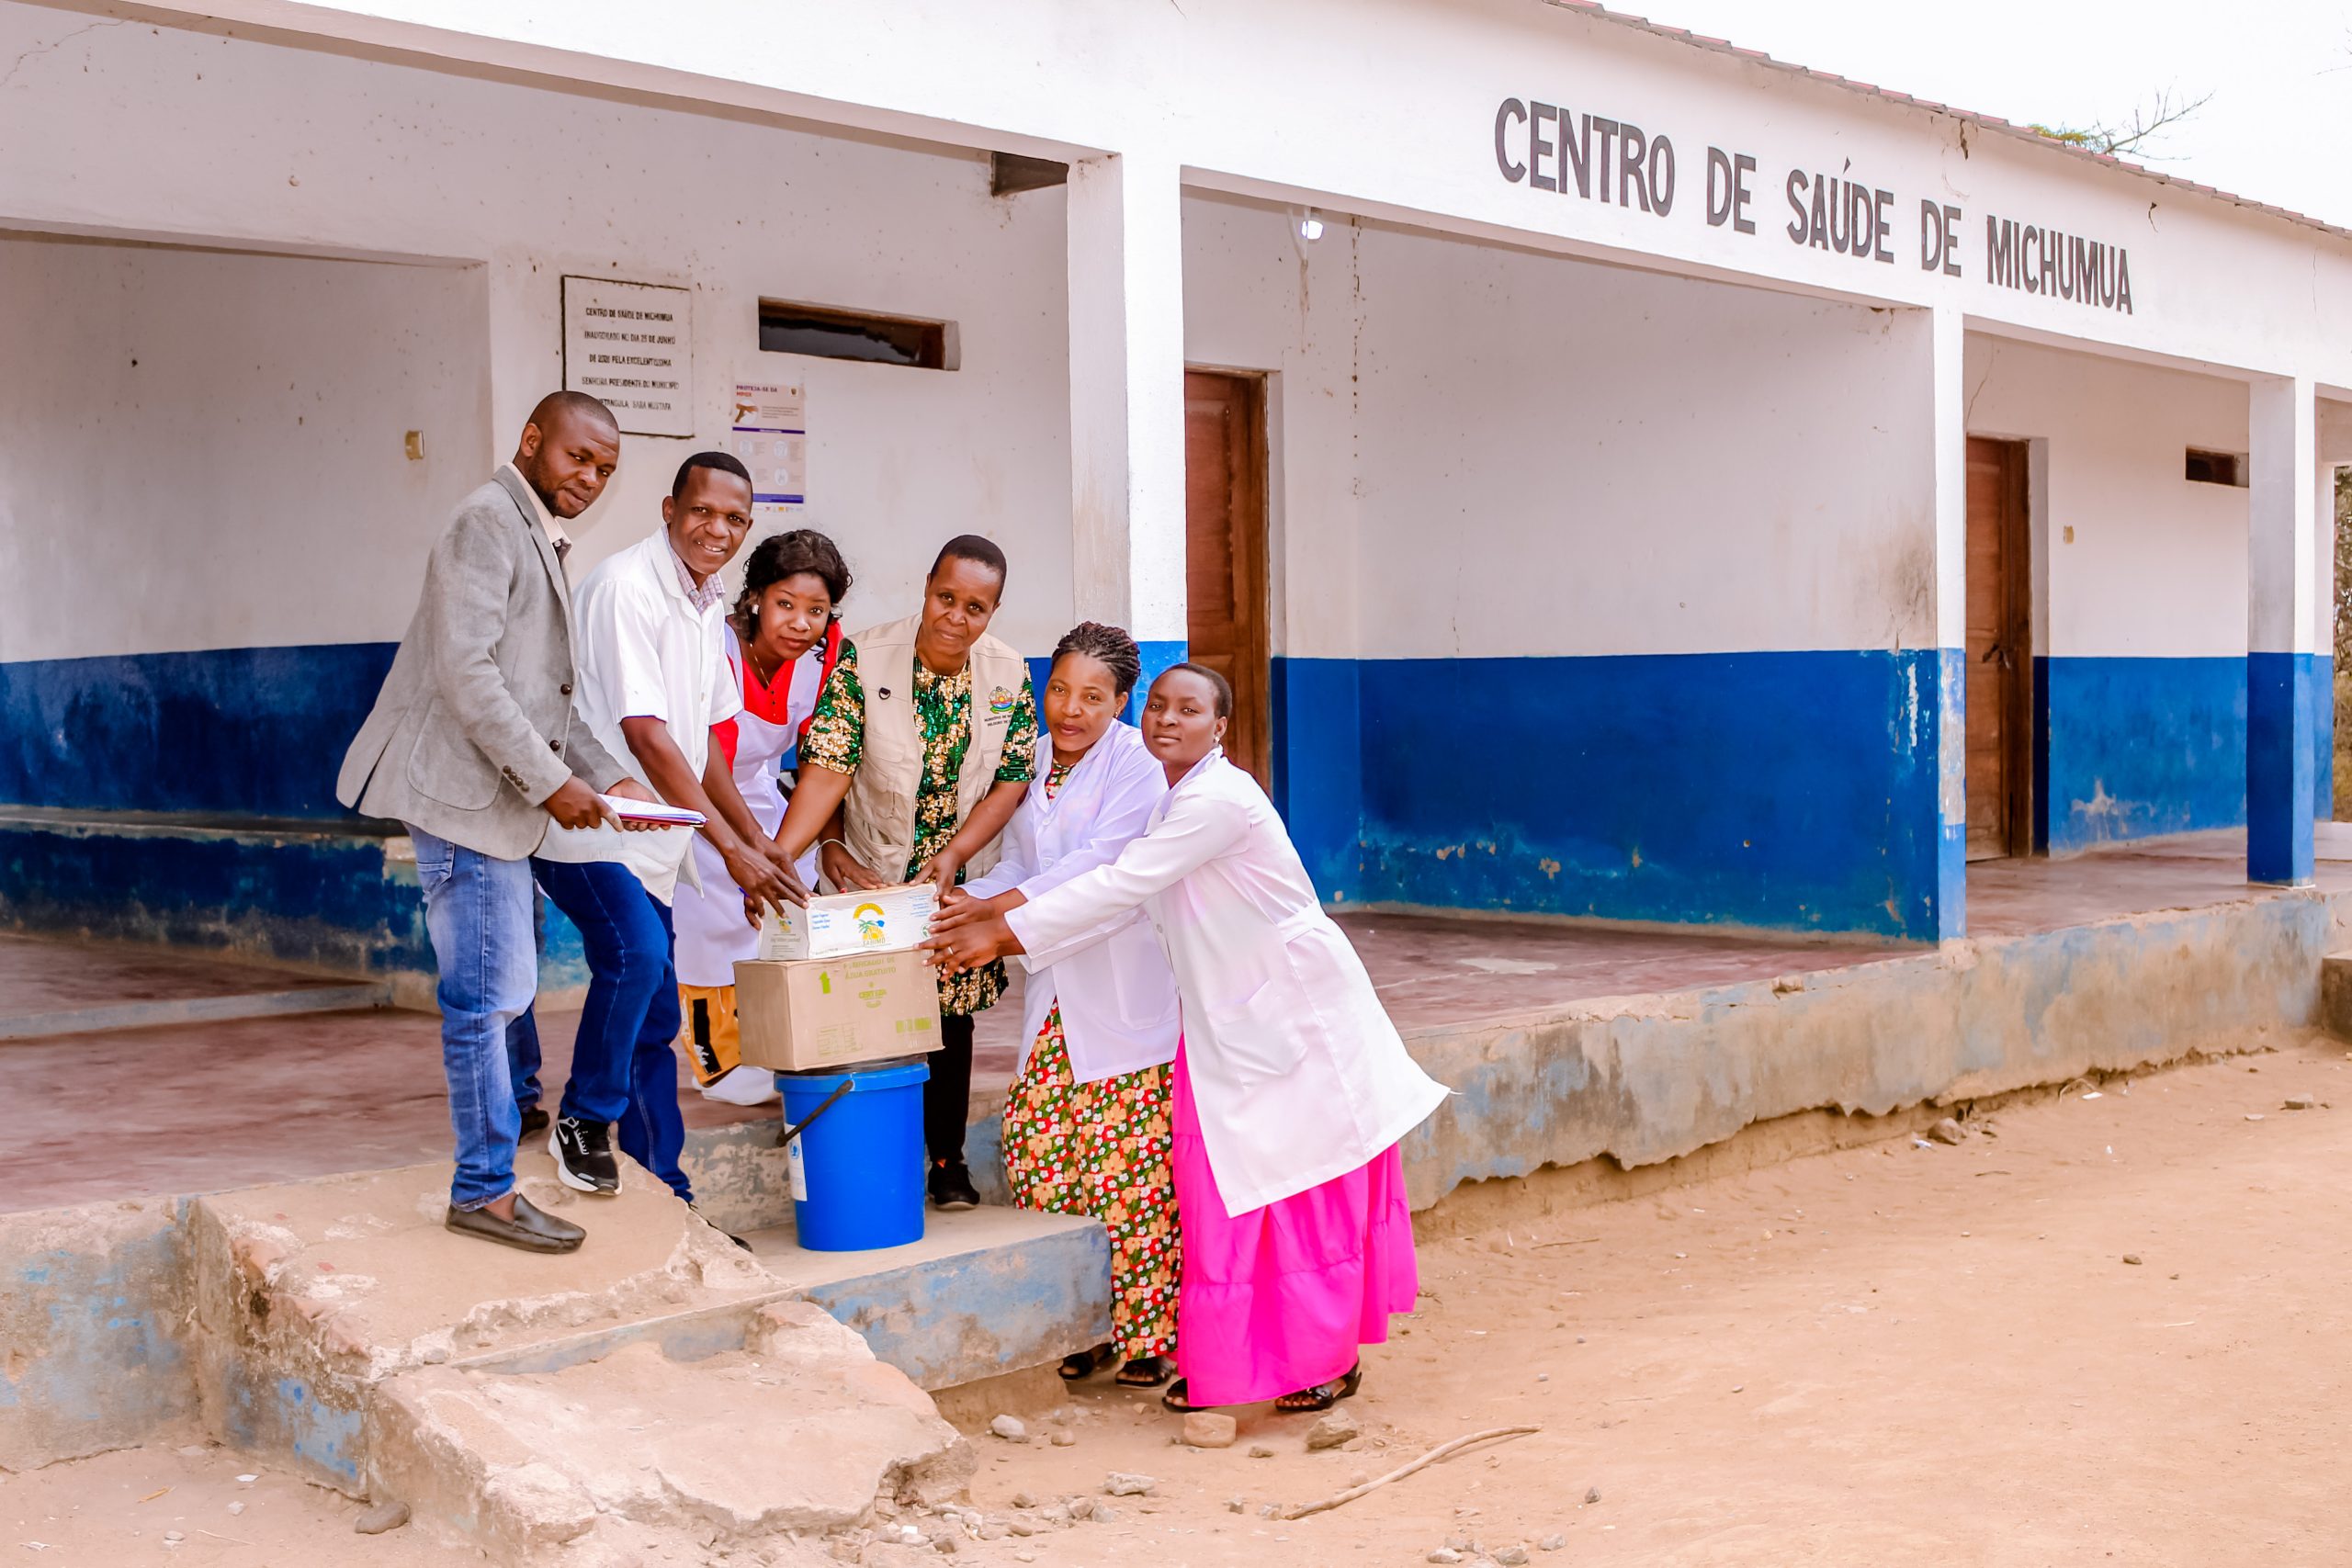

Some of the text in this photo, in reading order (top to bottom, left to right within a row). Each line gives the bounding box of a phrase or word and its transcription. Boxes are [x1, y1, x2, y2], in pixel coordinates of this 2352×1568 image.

[1495, 97, 2132, 315] CENTRO DE SAÚDE DE MICHUMUA
[586, 308, 607, 317] CENTRO
[609, 309, 616, 317] DE
[636, 311, 642, 320] DE
[630, 333, 639, 343] DIA
[649, 334, 655, 343] DE
[657, 335, 675, 344] JUNHO
[589, 354, 596, 363] DE
[612, 355, 626, 364] PELA
